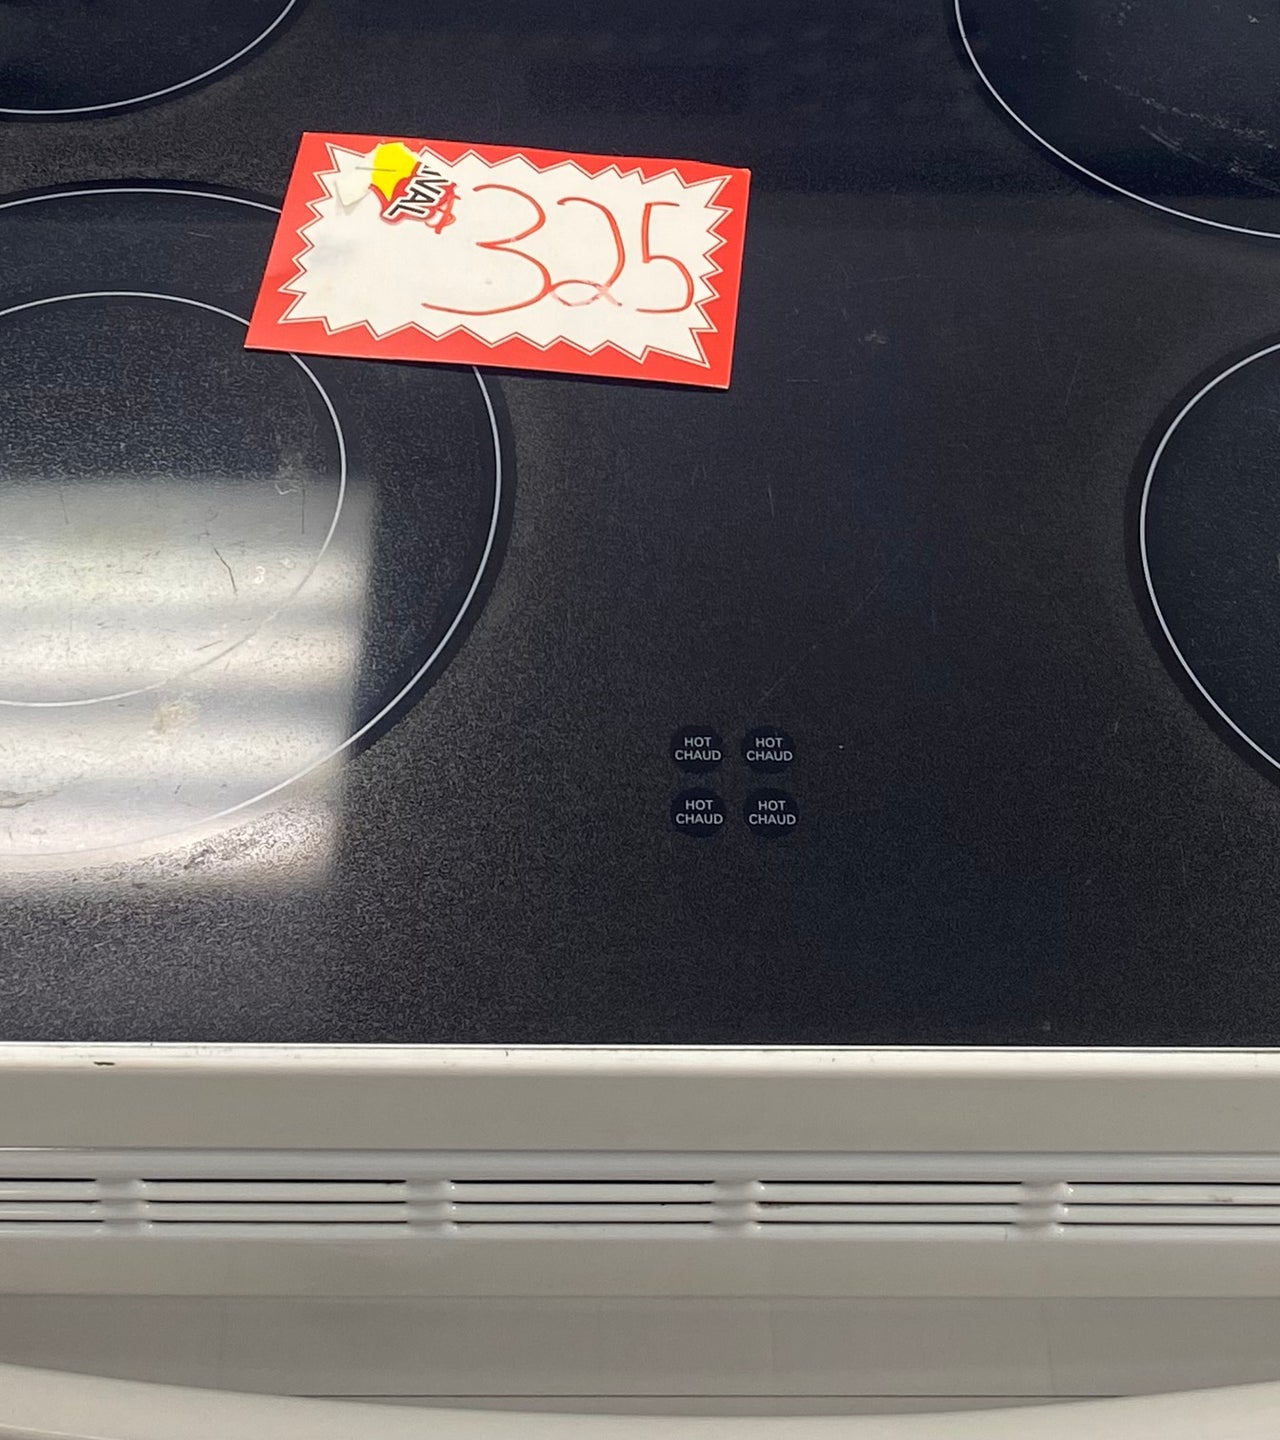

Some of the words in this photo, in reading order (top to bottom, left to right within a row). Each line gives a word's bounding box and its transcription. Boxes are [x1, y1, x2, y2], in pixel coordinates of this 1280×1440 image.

[684, 736, 712, 747] HOT
[755, 737, 784, 748] HOT
[674, 750, 721, 761] CHAUD
[746, 750, 793, 761] CHAUD
[685, 799, 713, 810] HOT
[758, 800, 786, 811] HOT
[675, 813, 723, 825] CHAUD
[748, 813, 796, 825] CHAUD
